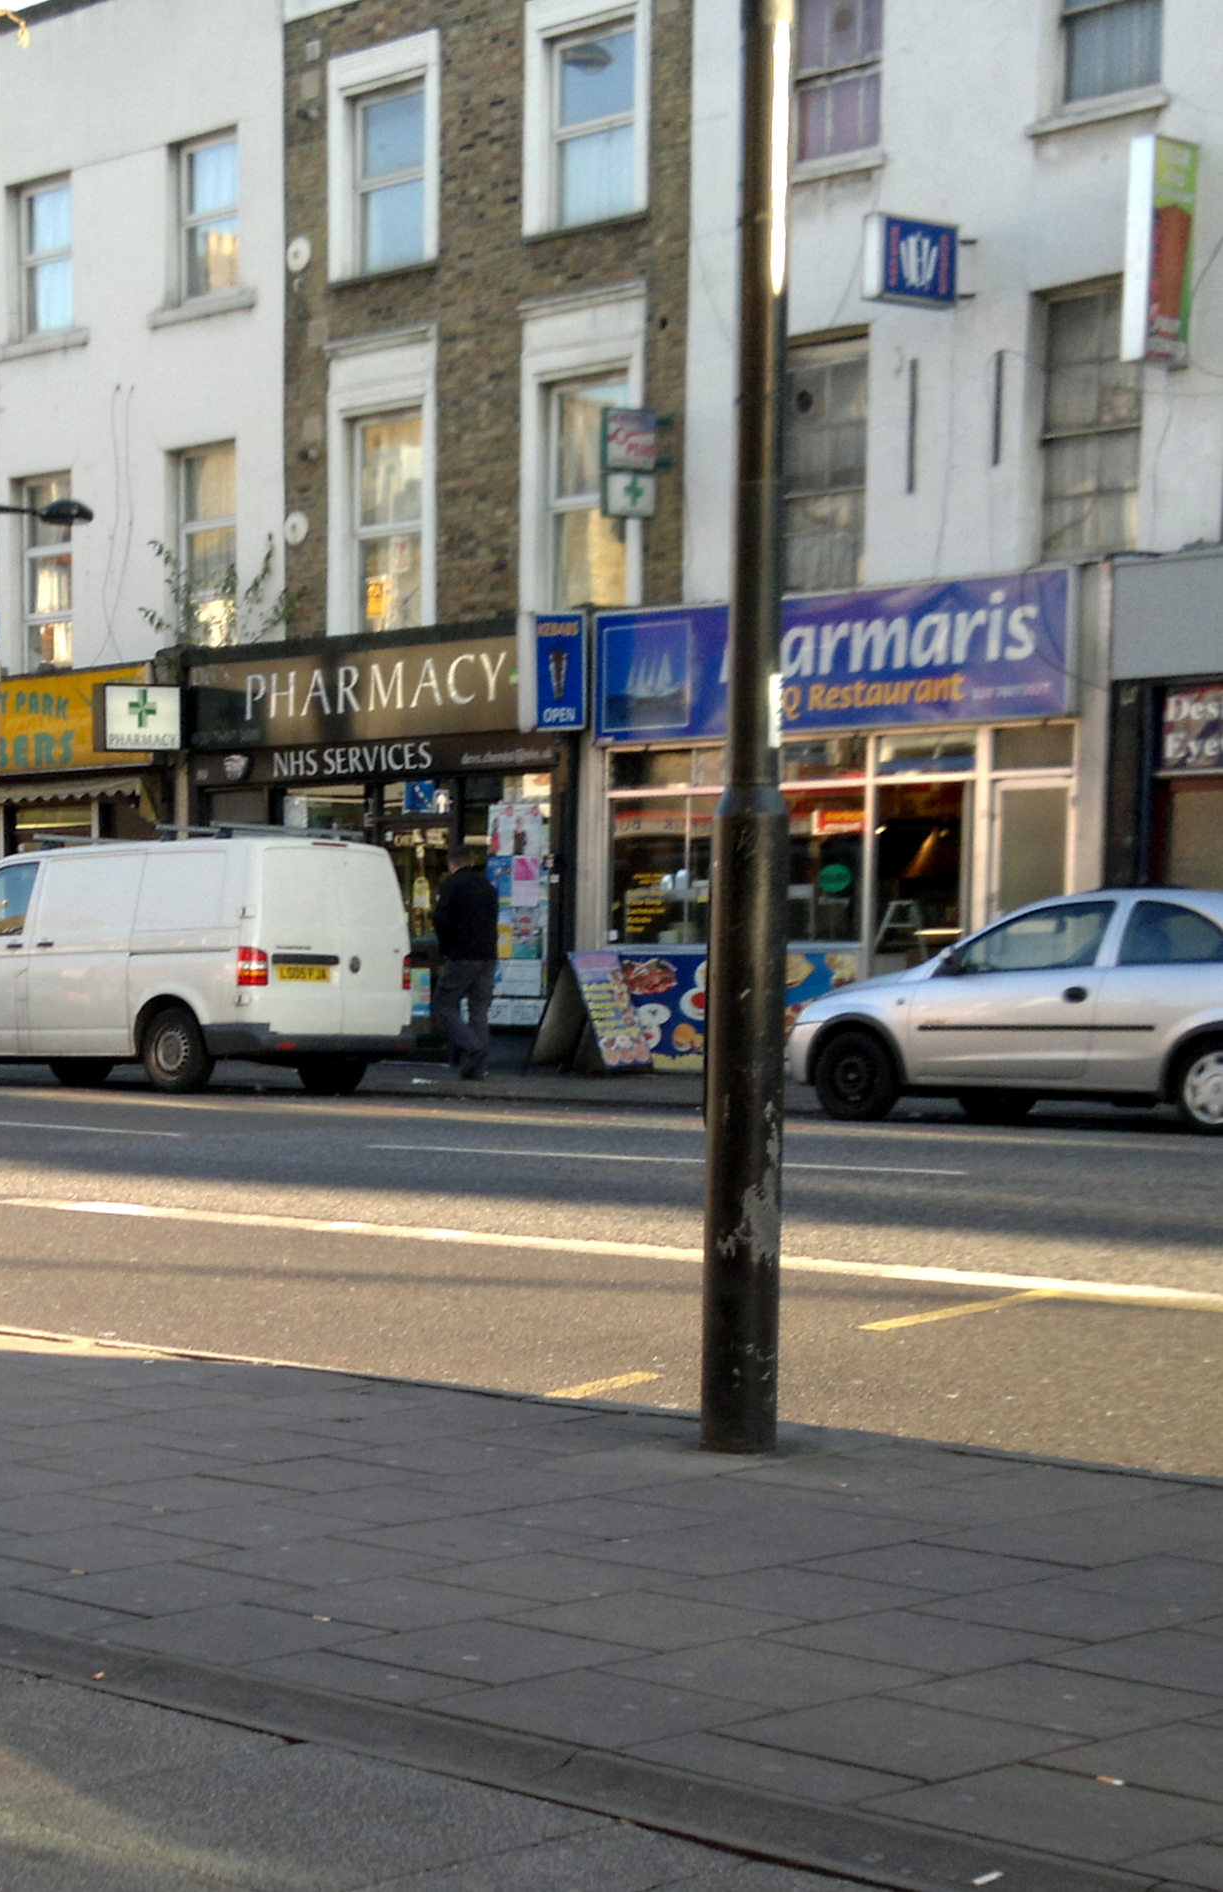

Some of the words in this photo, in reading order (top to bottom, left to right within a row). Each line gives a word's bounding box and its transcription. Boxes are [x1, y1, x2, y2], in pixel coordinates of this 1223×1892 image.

[718, 589, 1039, 684] armaris
[244, 651, 507, 721] PHARMACY
[808, 671, 967, 712] Restaurant
[15, 690, 69, 721] PARK
[542, 706, 577, 723] OPEN
[109, 732, 178, 748] PHARMACY
[1164, 732, 1223, 763] Eye
[273, 751, 318, 778] NHS
[322, 741, 433, 775] SERVICES
